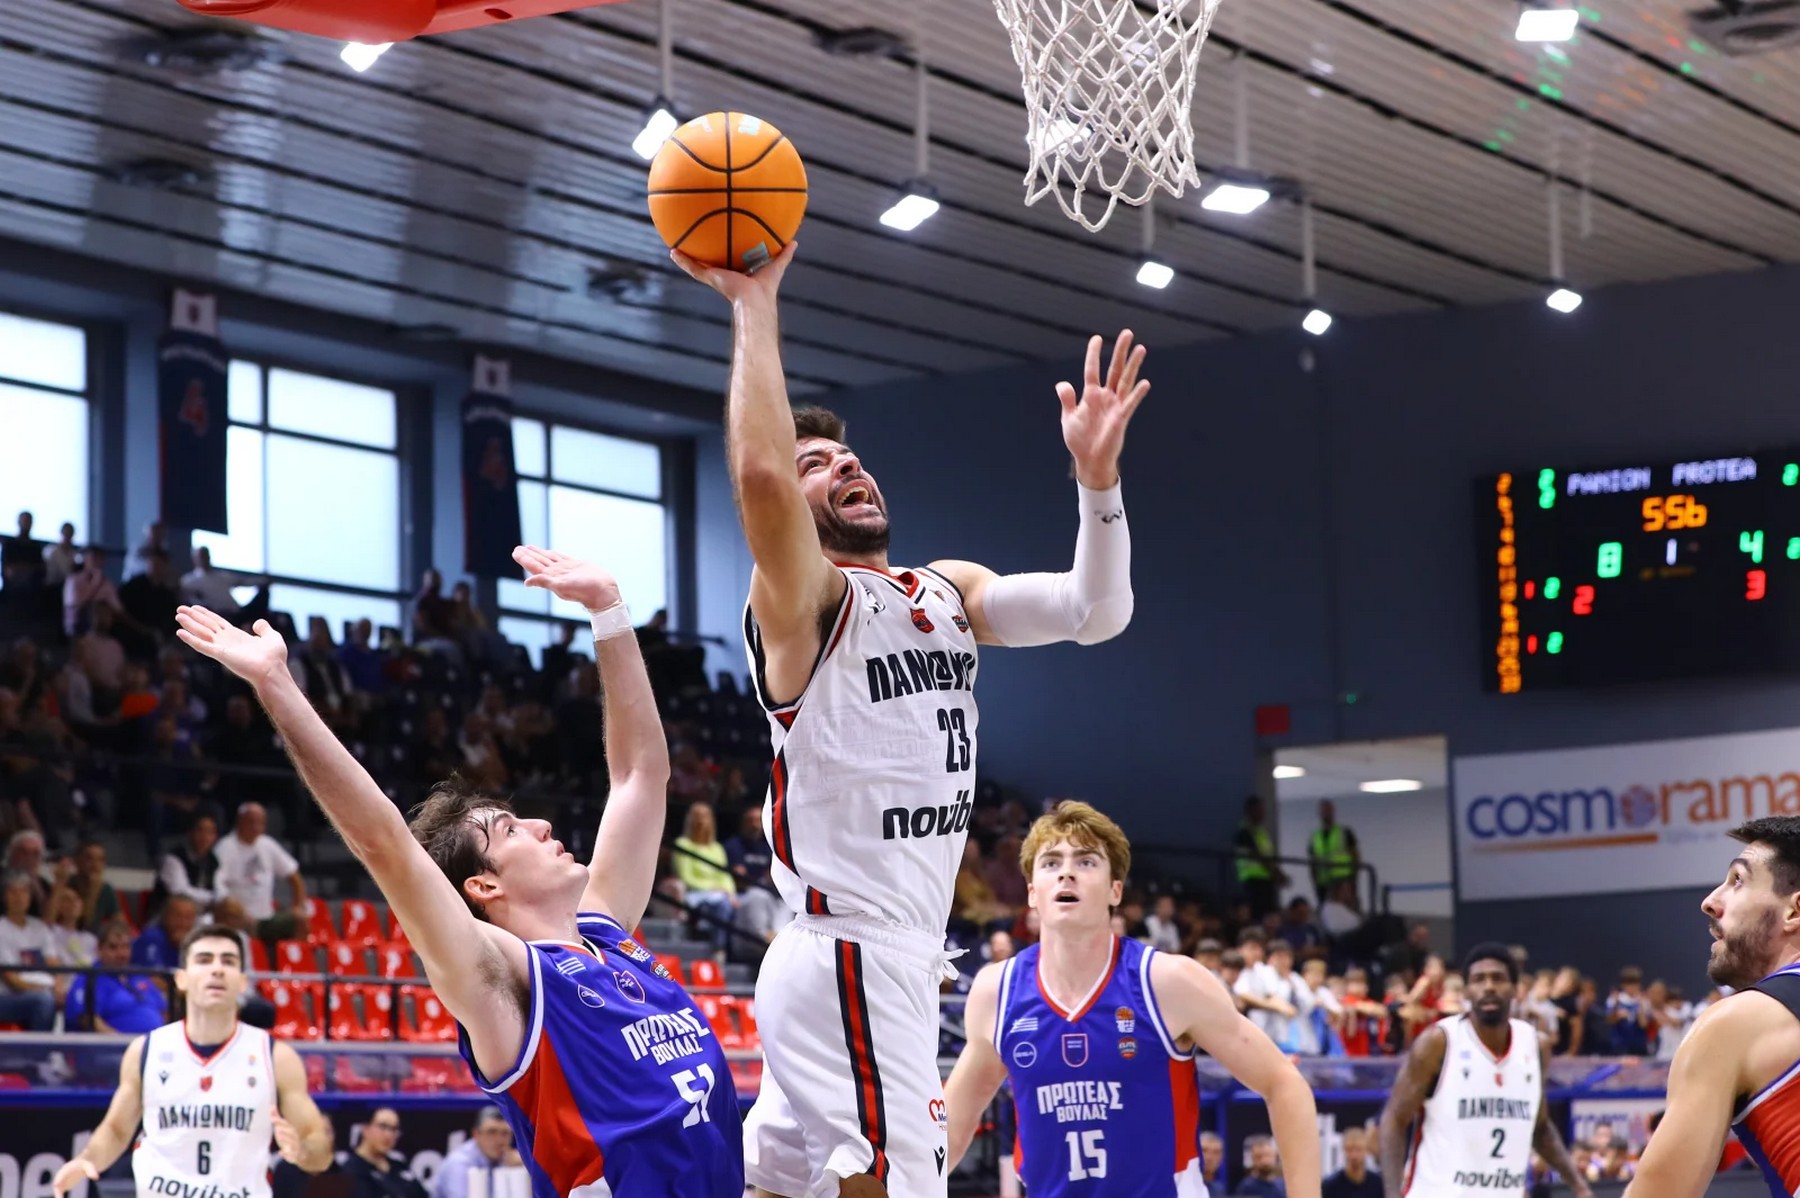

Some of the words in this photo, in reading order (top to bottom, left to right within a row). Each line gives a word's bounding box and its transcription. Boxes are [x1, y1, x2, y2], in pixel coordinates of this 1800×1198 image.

[1739, 530, 1764, 563] 4
[1572, 585, 1595, 615] 2
[1745, 569, 1766, 600] 3
[936, 708, 971, 773] 23
[882, 789, 972, 840] novib
[1466, 771, 1800, 840] cosmorama
[620, 1007, 711, 1062] ΠΡΩΤΕΑΣ
[650, 1033, 704, 1066] ΒΟΥΛΑΣ
[1036, 1080, 1124, 1115] ΠΡΩΤΕΑΣ
[1056, 1103, 1108, 1123] ΒΟΥΛΑΣ
[197, 1140, 211, 1176] 6
[1065, 1129, 1107, 1182] 15
[1490, 1127, 1506, 1159] 2
